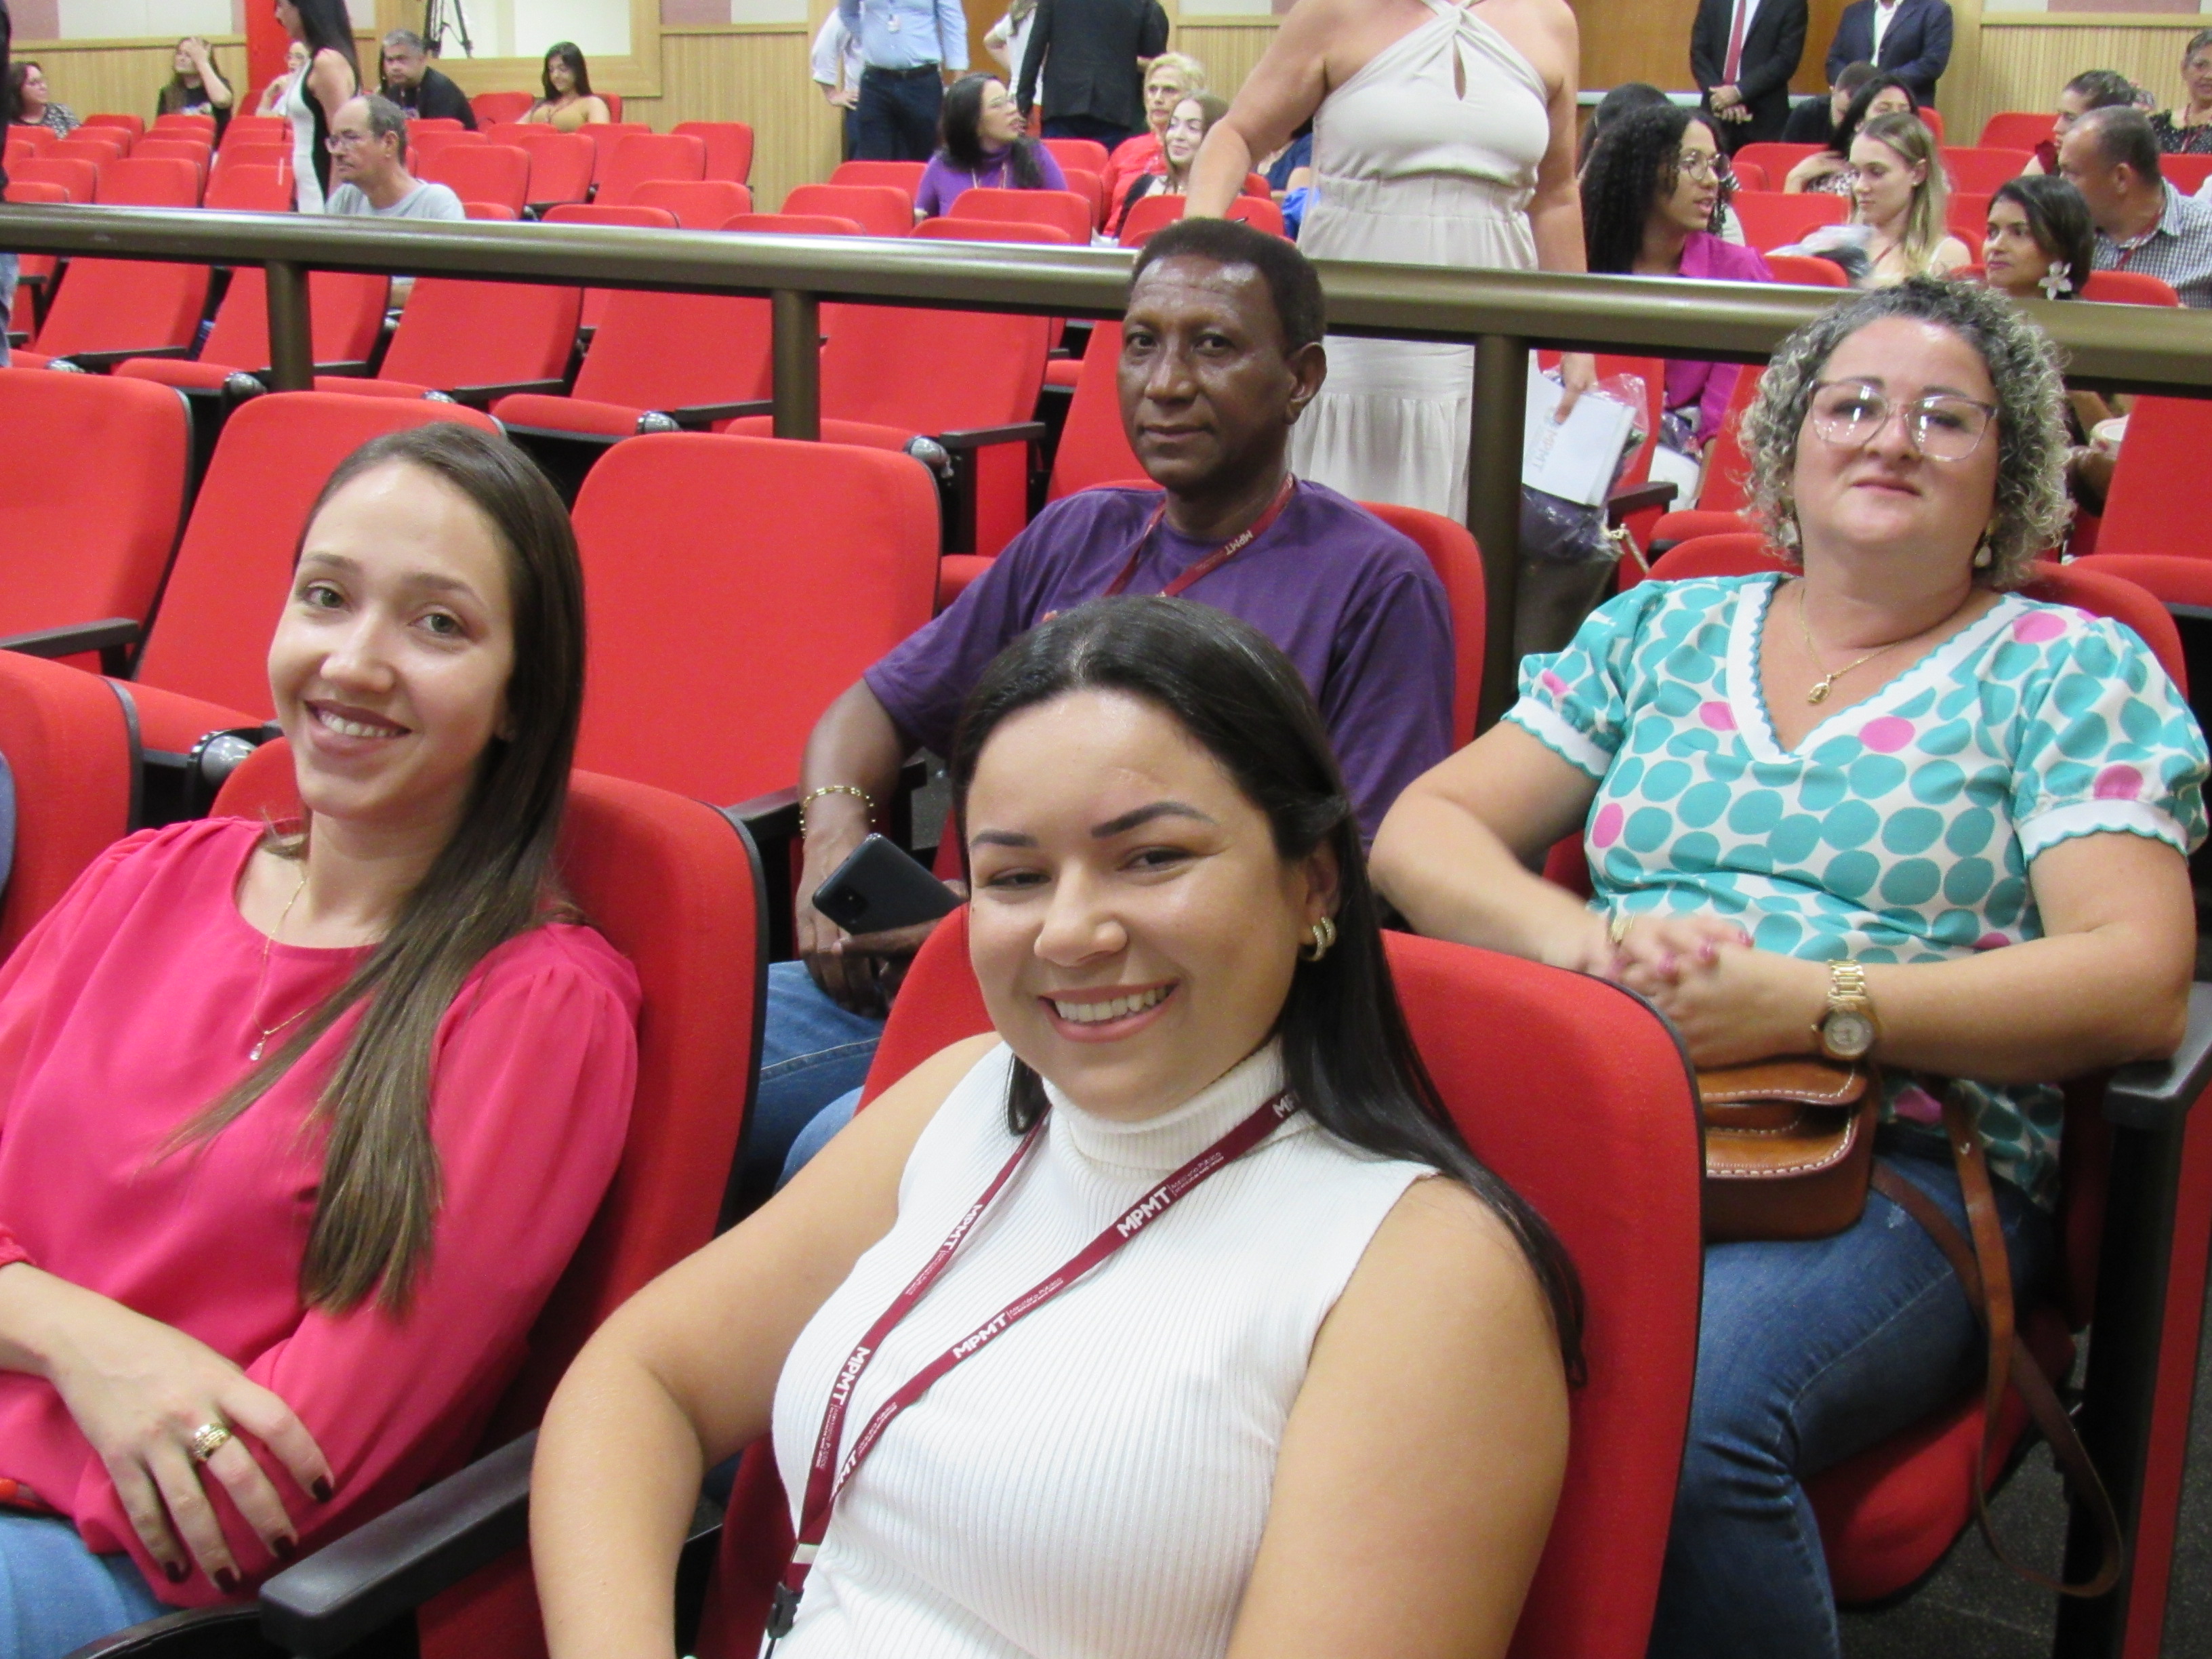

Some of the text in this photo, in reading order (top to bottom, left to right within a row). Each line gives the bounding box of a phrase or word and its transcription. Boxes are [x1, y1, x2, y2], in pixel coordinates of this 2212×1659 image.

[1225, 529, 1252, 556] MPMT
[943, 1204, 983, 1250] MPMT
[1116, 1186, 1170, 1237] MPMT
[952, 1312, 1006, 1359] MPMT
[832, 1346, 870, 1406] MPMT
